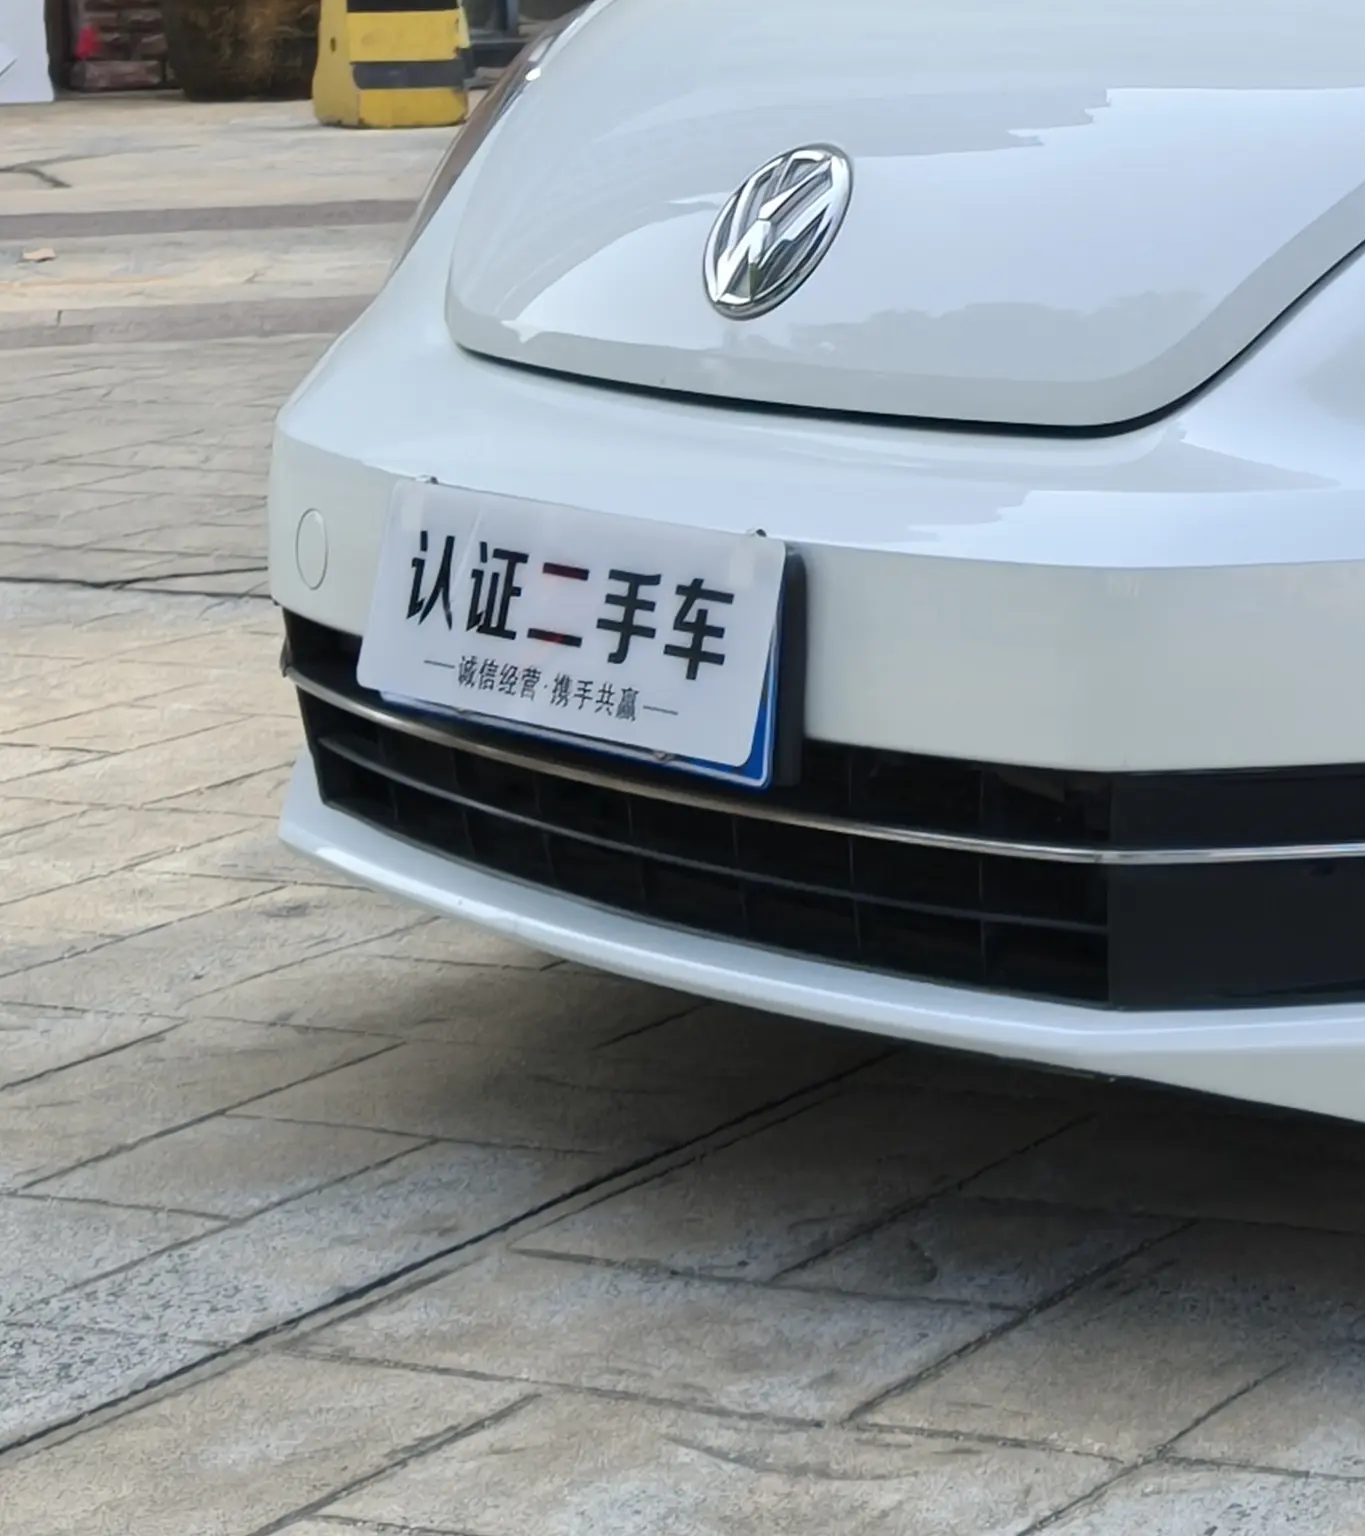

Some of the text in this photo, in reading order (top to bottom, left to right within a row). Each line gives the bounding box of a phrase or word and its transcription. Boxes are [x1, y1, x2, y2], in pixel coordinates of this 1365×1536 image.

[406, 530, 735, 681] 认证二手车
